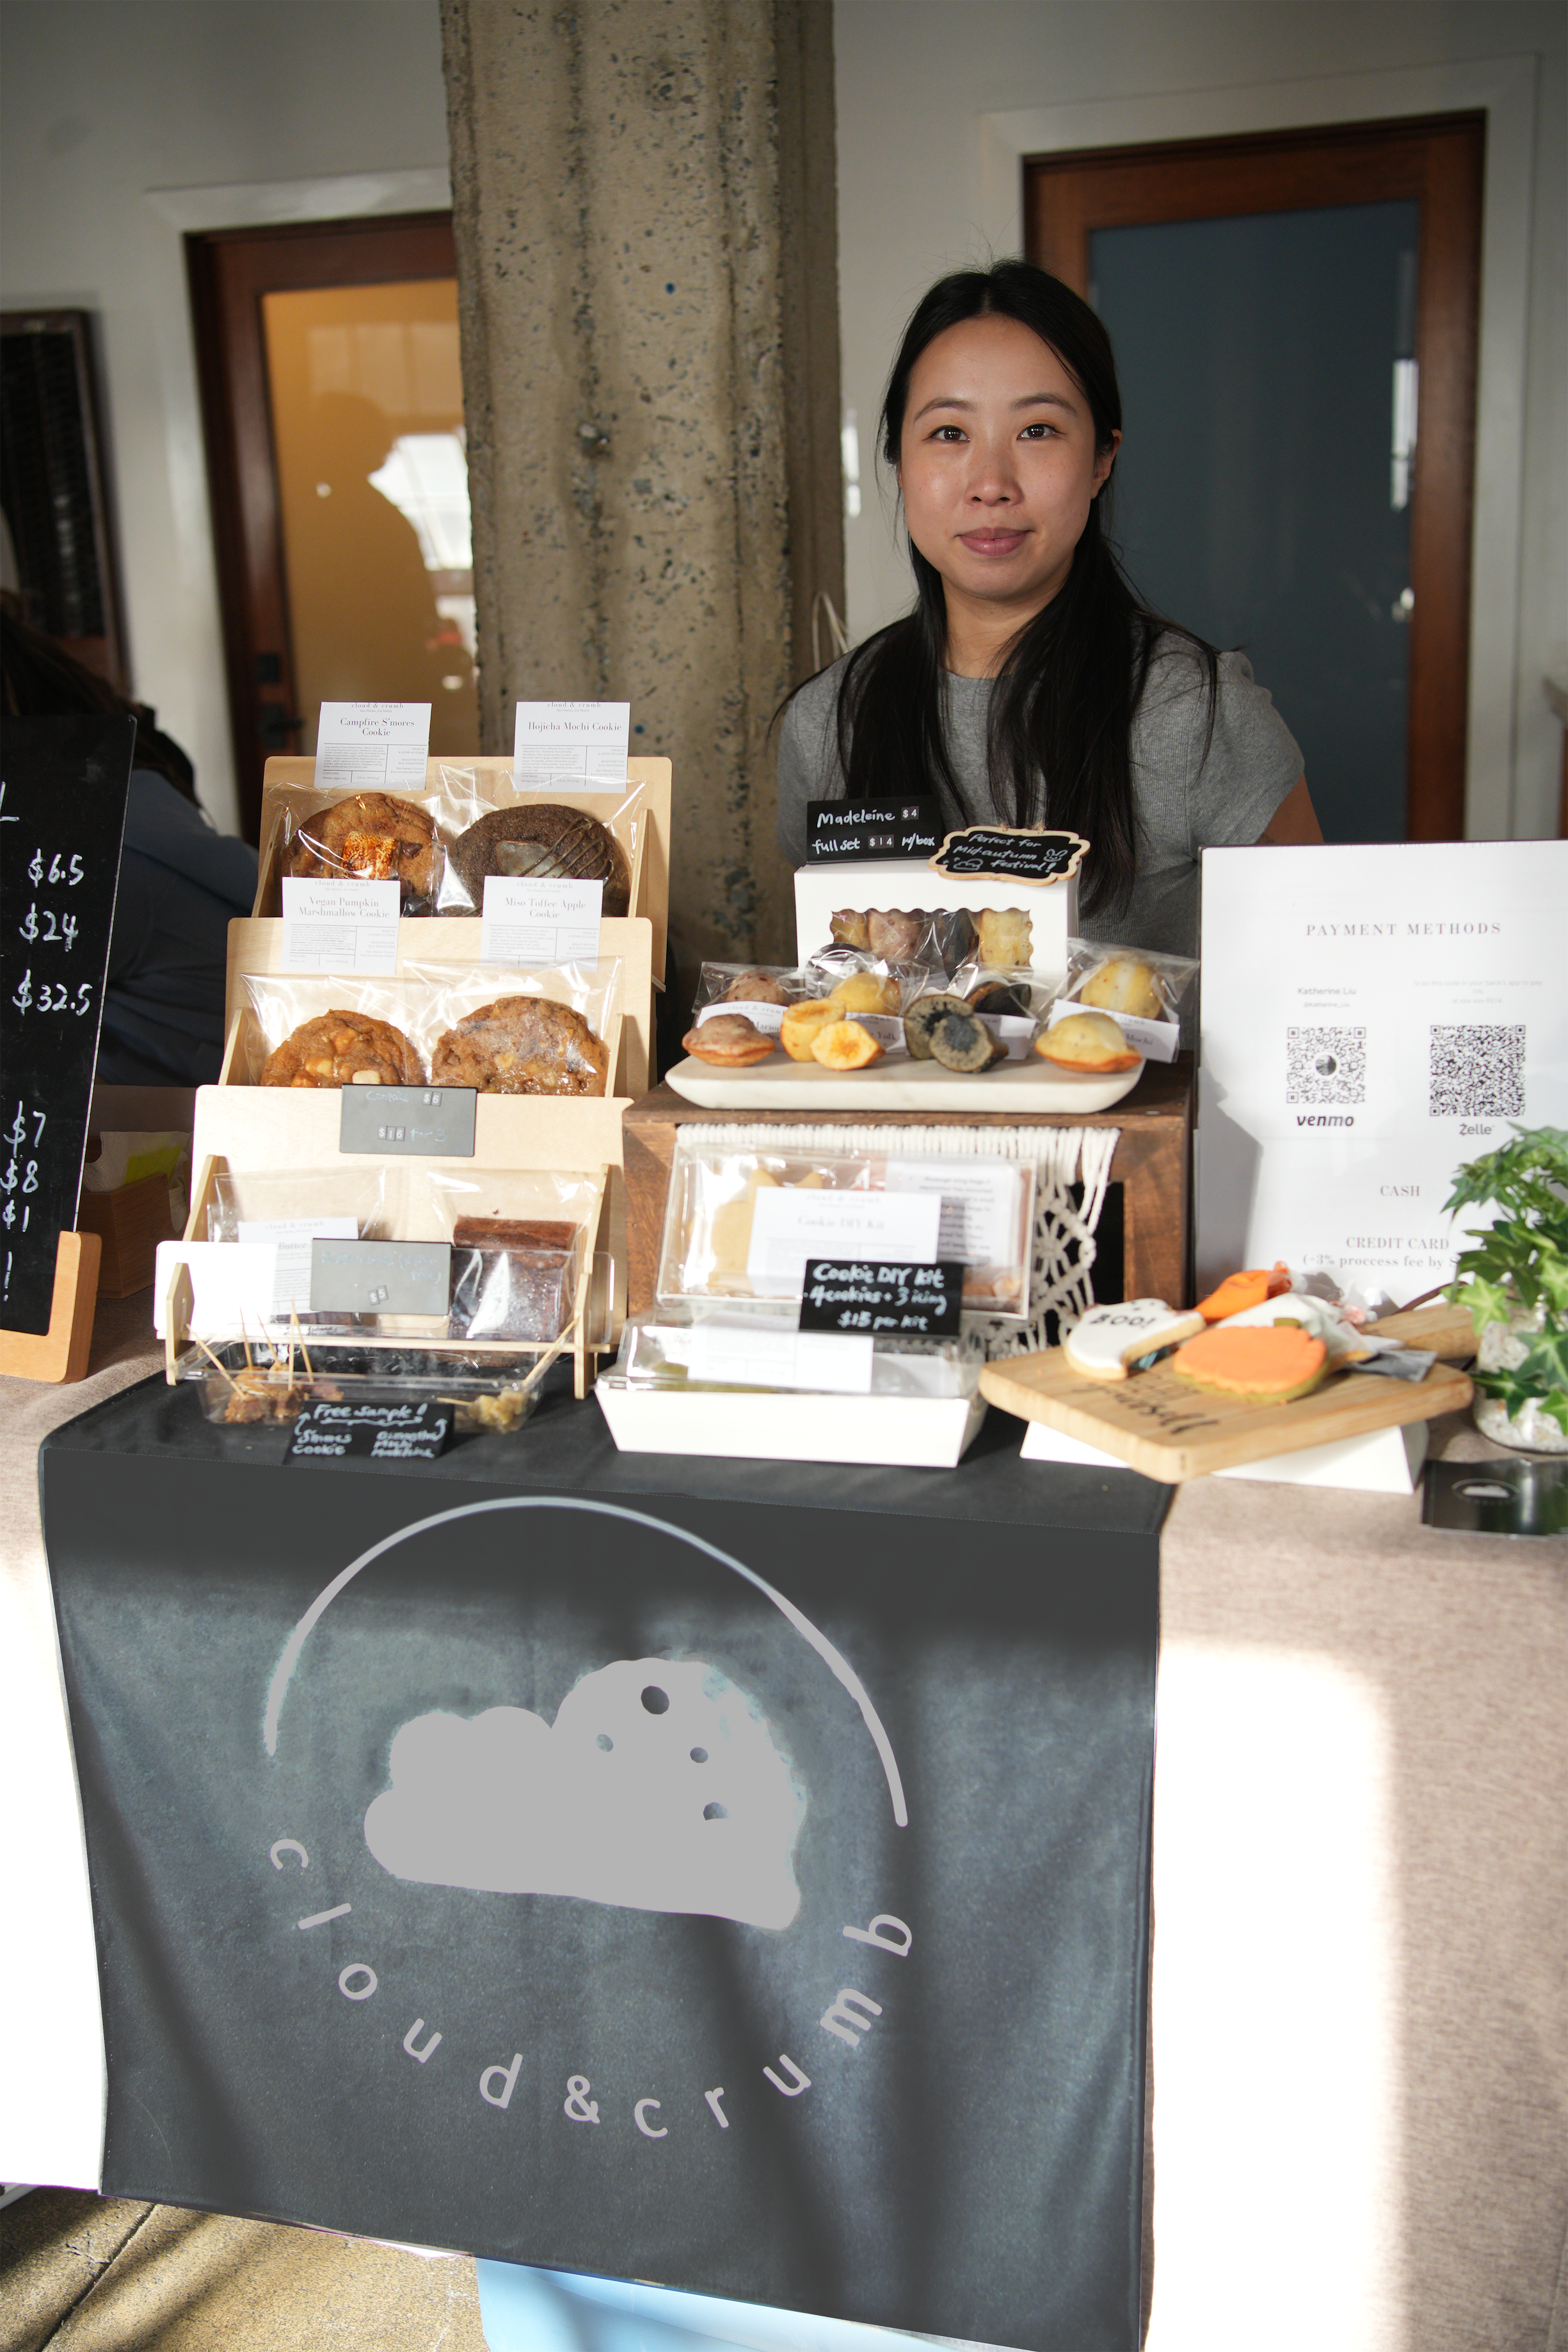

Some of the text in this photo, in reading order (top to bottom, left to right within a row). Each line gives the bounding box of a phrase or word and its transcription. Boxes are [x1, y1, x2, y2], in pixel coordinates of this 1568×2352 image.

[340, 717, 415, 728] Campfire S'mores
[529, 721, 621, 732] Hojicha Mochi Cookie
[363, 728, 390, 736] Cookie
[817, 808, 917, 828] Madeleine $4
[812, 834, 936, 855] full set $14 w/box
[968, 833, 1042, 847] Perfect for
[28, 849, 84, 887] $6.5
[310, 896, 379, 909] Vegan Pumpkin
[506, 897, 586, 911] Miso Toffee Apple
[299, 906, 390, 918] Marshmallow Cookie
[530, 909, 560, 918] Cookie
[19, 902, 79, 952] $24
[1306, 922, 1501, 936] PAYMENT METHODS
[12, 968, 92, 1016] $32.5
[1297, 987, 1357, 995] Katherine Liu
[424, 1093, 440, 1104] $6
[4, 1100, 45, 1156] $7
[1297, 1115, 1355, 1128] venmo
[378, 1128, 447, 1142] $16 for 3
[1459, 1123, 1492, 1136] Zelle
[1, 1156, 39, 1196] $8
[1380, 1185, 1420, 1197] CASH
[3, 1199, 29, 1231] $1
[1346, 1237, 1449, 1250] CREDIT CARD
[1340, 1256, 1399, 1268] proccess
[1404, 1255, 1425, 1267] fee
[1428, 1255, 1444, 1268] by
[813, 1263, 874, 1284] Cookie
[877, 1267, 913, 1286] DIY
[370, 1289, 386, 1302] $5
[824, 1285, 883, 1304] cookies
[894, 1286, 910, 1307] 3
[911, 1289, 947, 1316] icing
[837, 1309, 872, 1329] $15
[314, 1404, 352, 1420] Free
